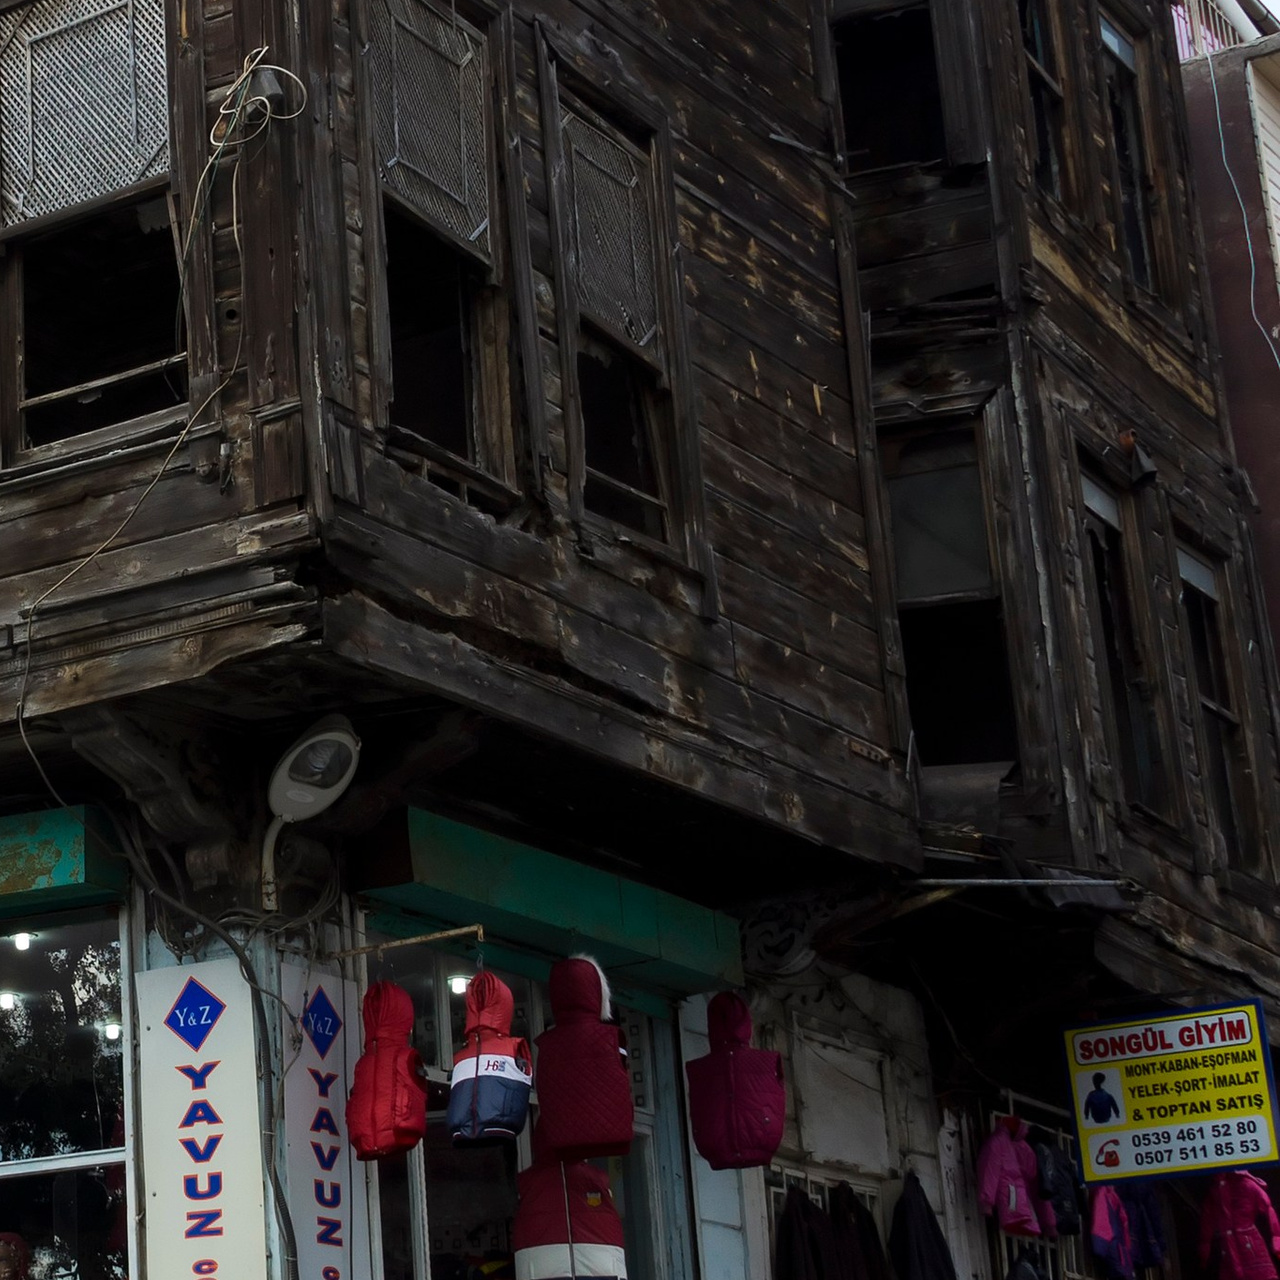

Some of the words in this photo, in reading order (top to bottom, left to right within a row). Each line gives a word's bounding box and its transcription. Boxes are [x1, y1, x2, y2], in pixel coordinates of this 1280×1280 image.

[1079, 1027, 1173, 1061] SONGÜL
[1178, 1017, 1247, 1047] GİYİM
[1132, 1108, 1144, 1121] &
[1146, 1100, 1211, 1120] TOPTAN
[1216, 1093, 1264, 1111] SATIŞ
[174, 1060, 224, 1239] YAVUZ
[1131, 1131, 1170, 1148] 0539
[1176, 1126, 1205, 1142] 461
[1211, 1123, 1232, 1138] 52
[1236, 1120, 1257, 1134] 80
[307, 1067, 344, 1247] YAVUZ
[1134, 1149, 1173, 1166] 0507
[1179, 1145, 1208, 1161] 511
[1214, 1142, 1234, 1156] 85
[1240, 1139, 1260, 1153] 53
